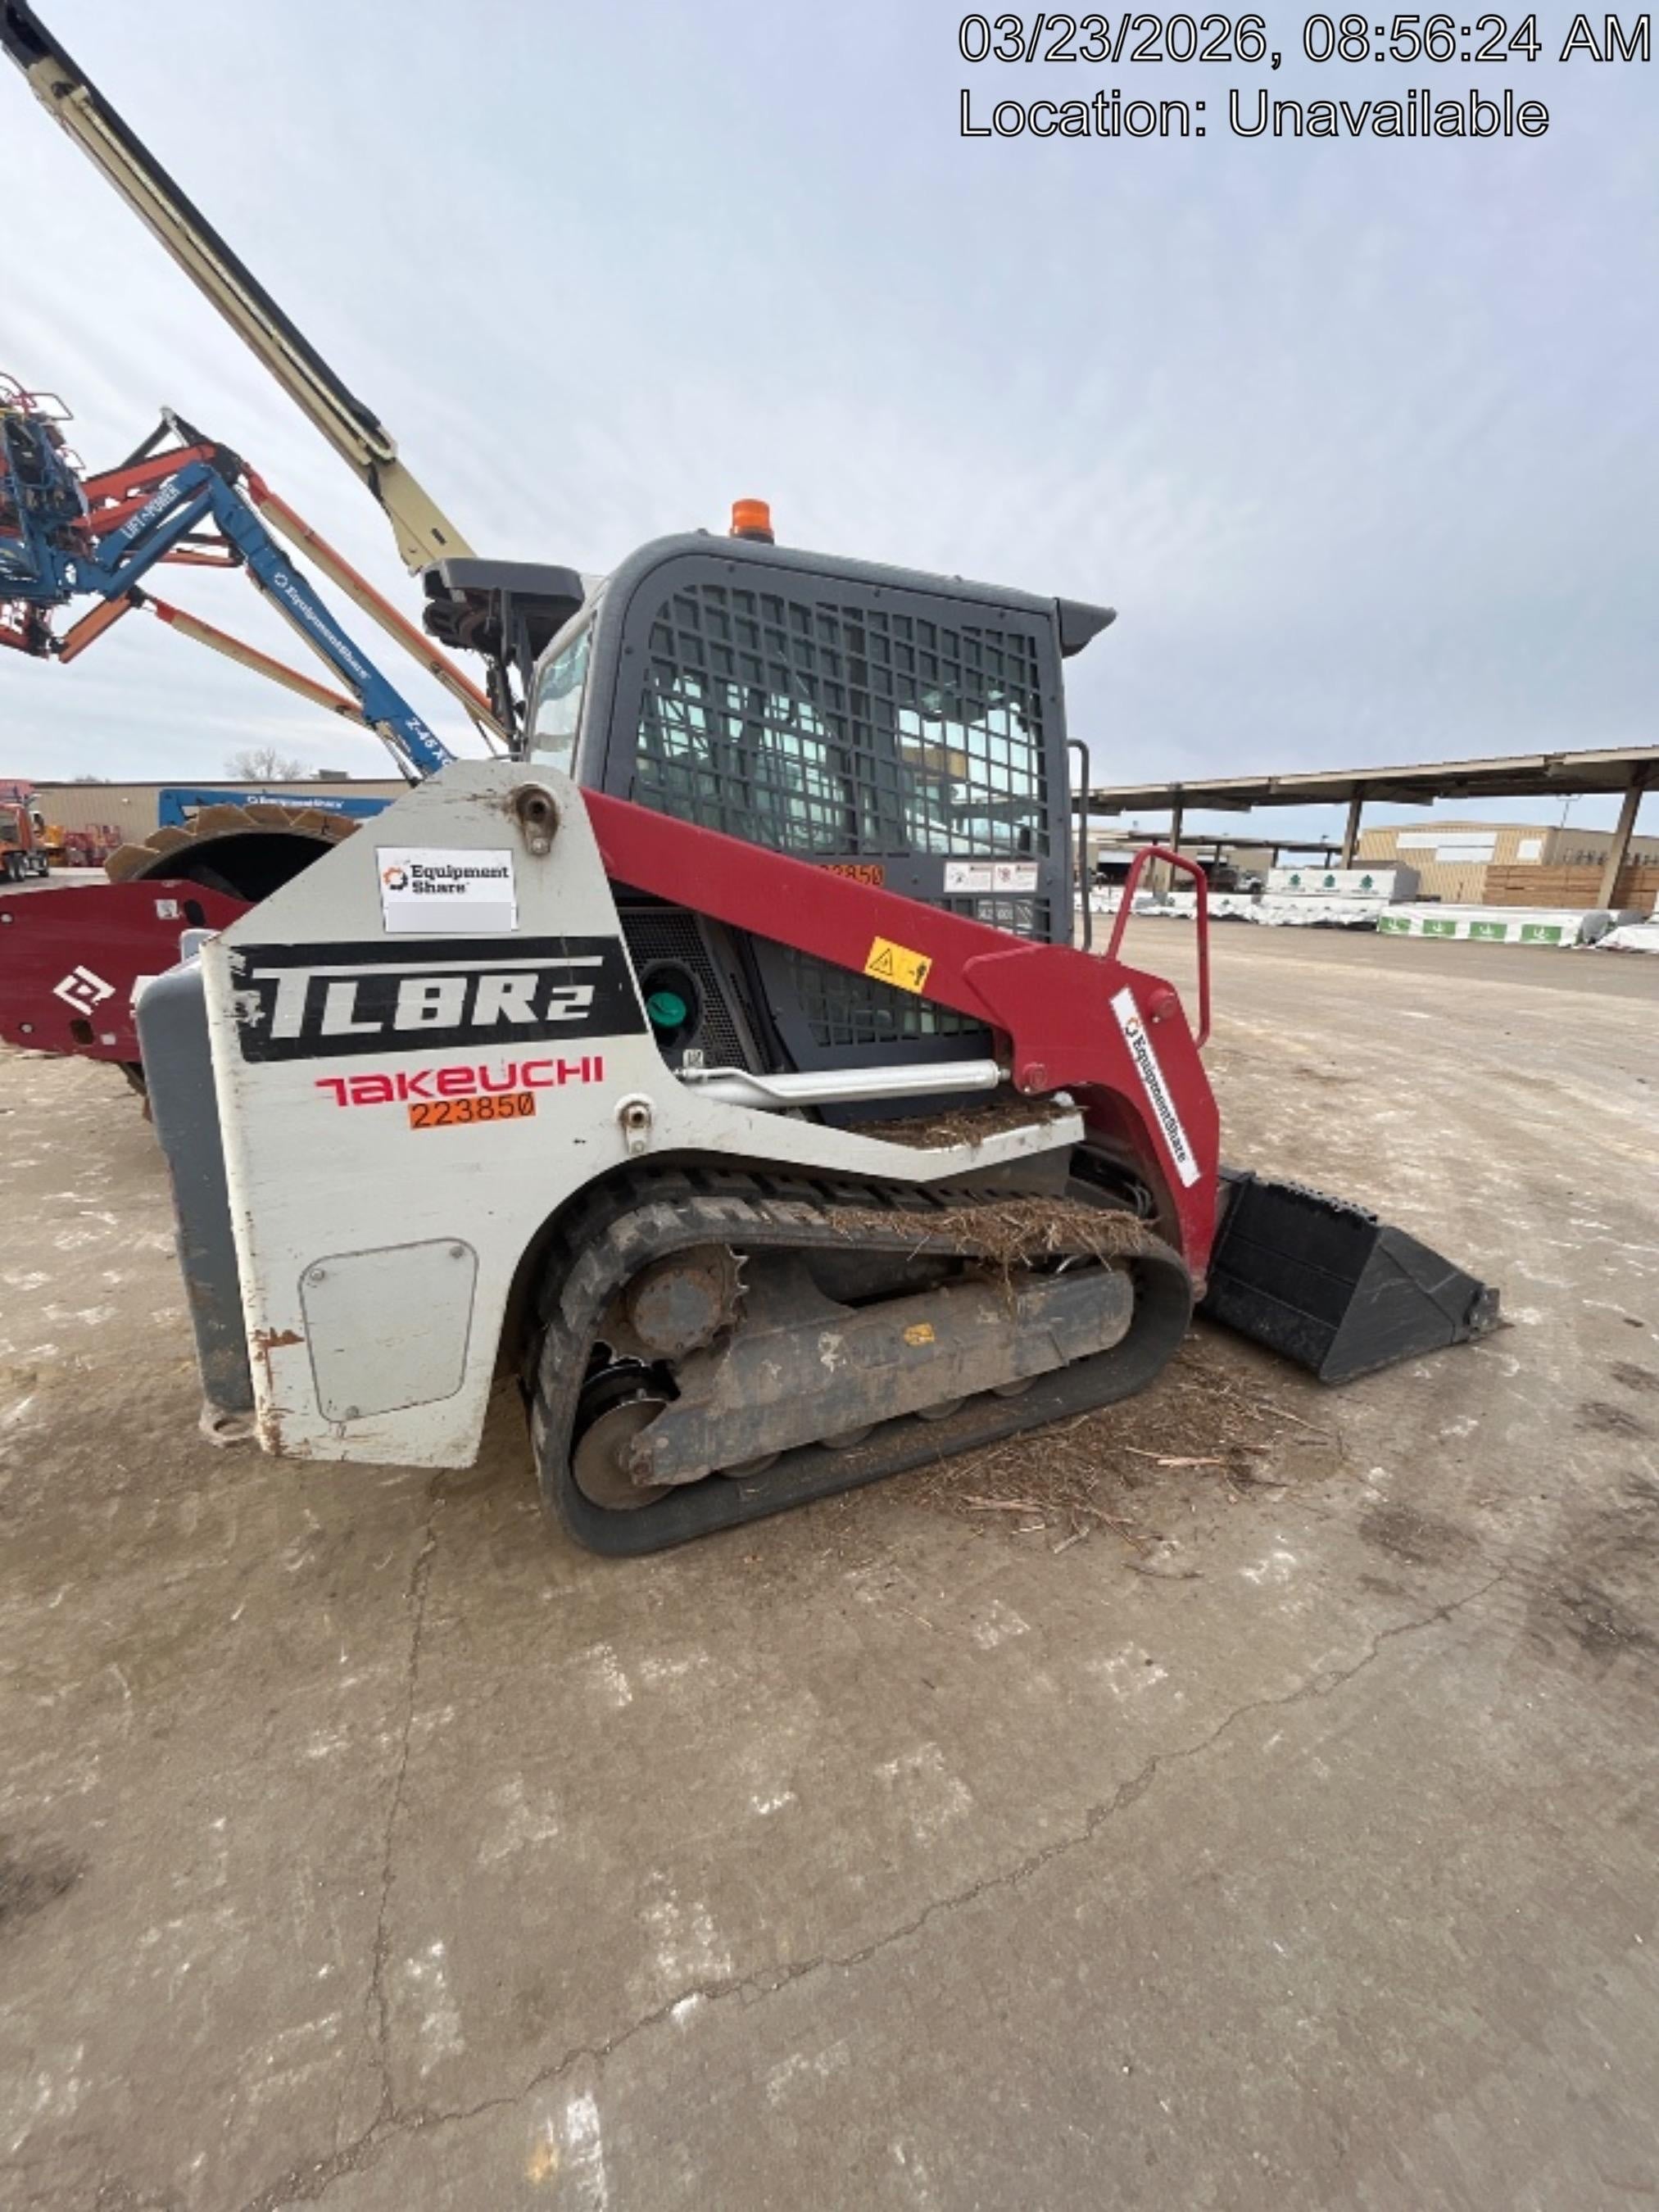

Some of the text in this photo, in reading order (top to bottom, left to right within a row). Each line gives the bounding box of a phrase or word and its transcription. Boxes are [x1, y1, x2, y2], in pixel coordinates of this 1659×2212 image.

[410, 864, 510, 881] Equipment
[412, 880, 467, 894] Share
[411, 1091, 535, 1129] 223850
[1132, 1035, 1187, 1163] EquipmentShare
